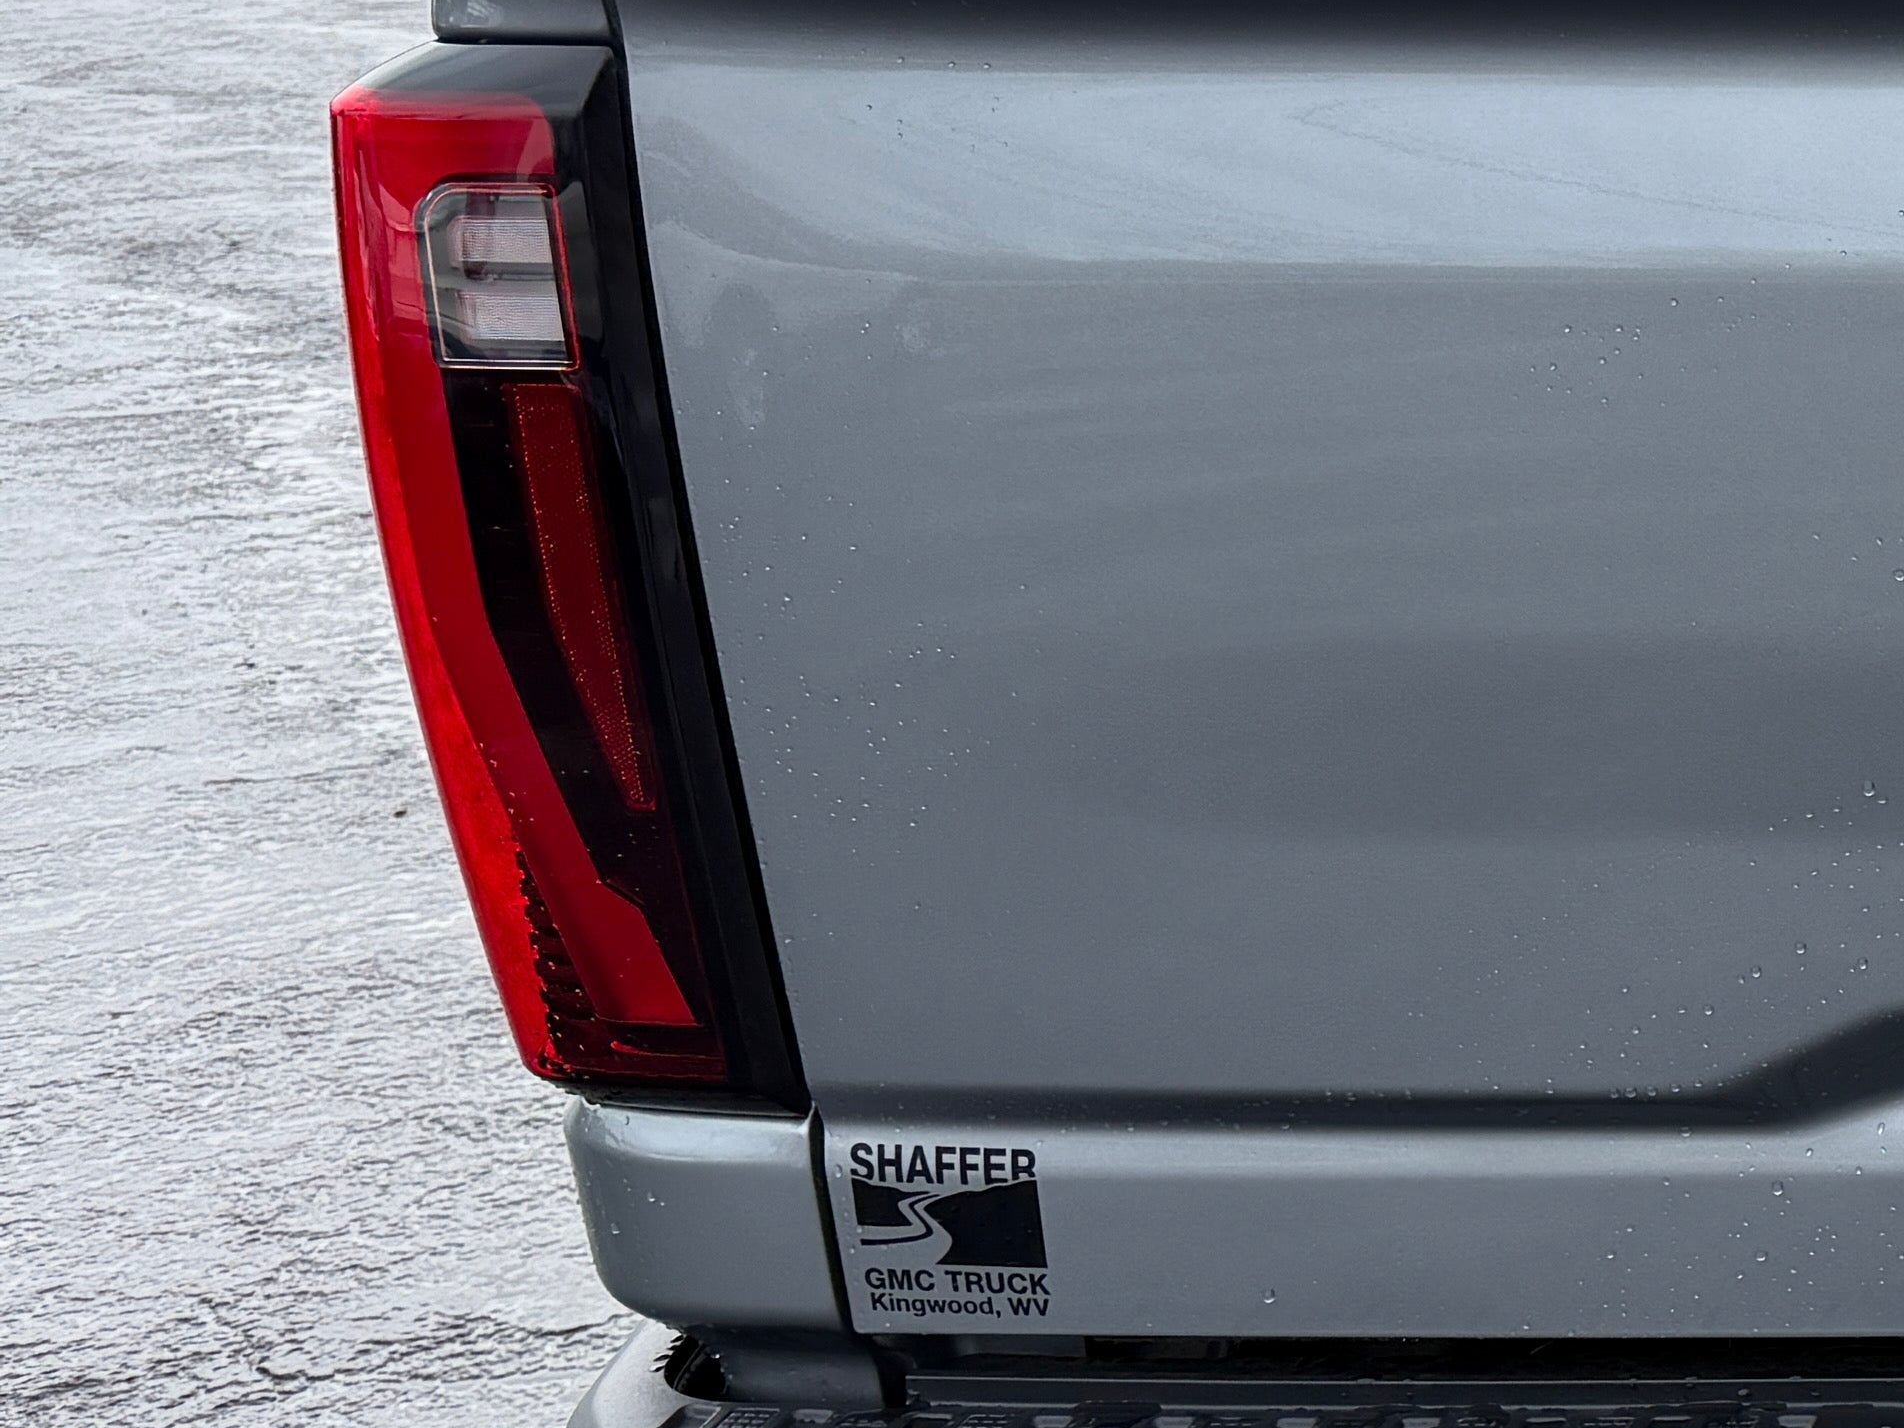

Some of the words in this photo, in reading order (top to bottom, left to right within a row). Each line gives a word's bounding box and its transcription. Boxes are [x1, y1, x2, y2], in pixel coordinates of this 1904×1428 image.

[850, 1142, 1036, 1185] SHAFFER
[865, 1267, 936, 1292] GMC
[944, 1270, 1051, 1296] TRUCK
[870, 1292, 1002, 1318] Kingwood,
[1007, 1296, 1050, 1317] WV
